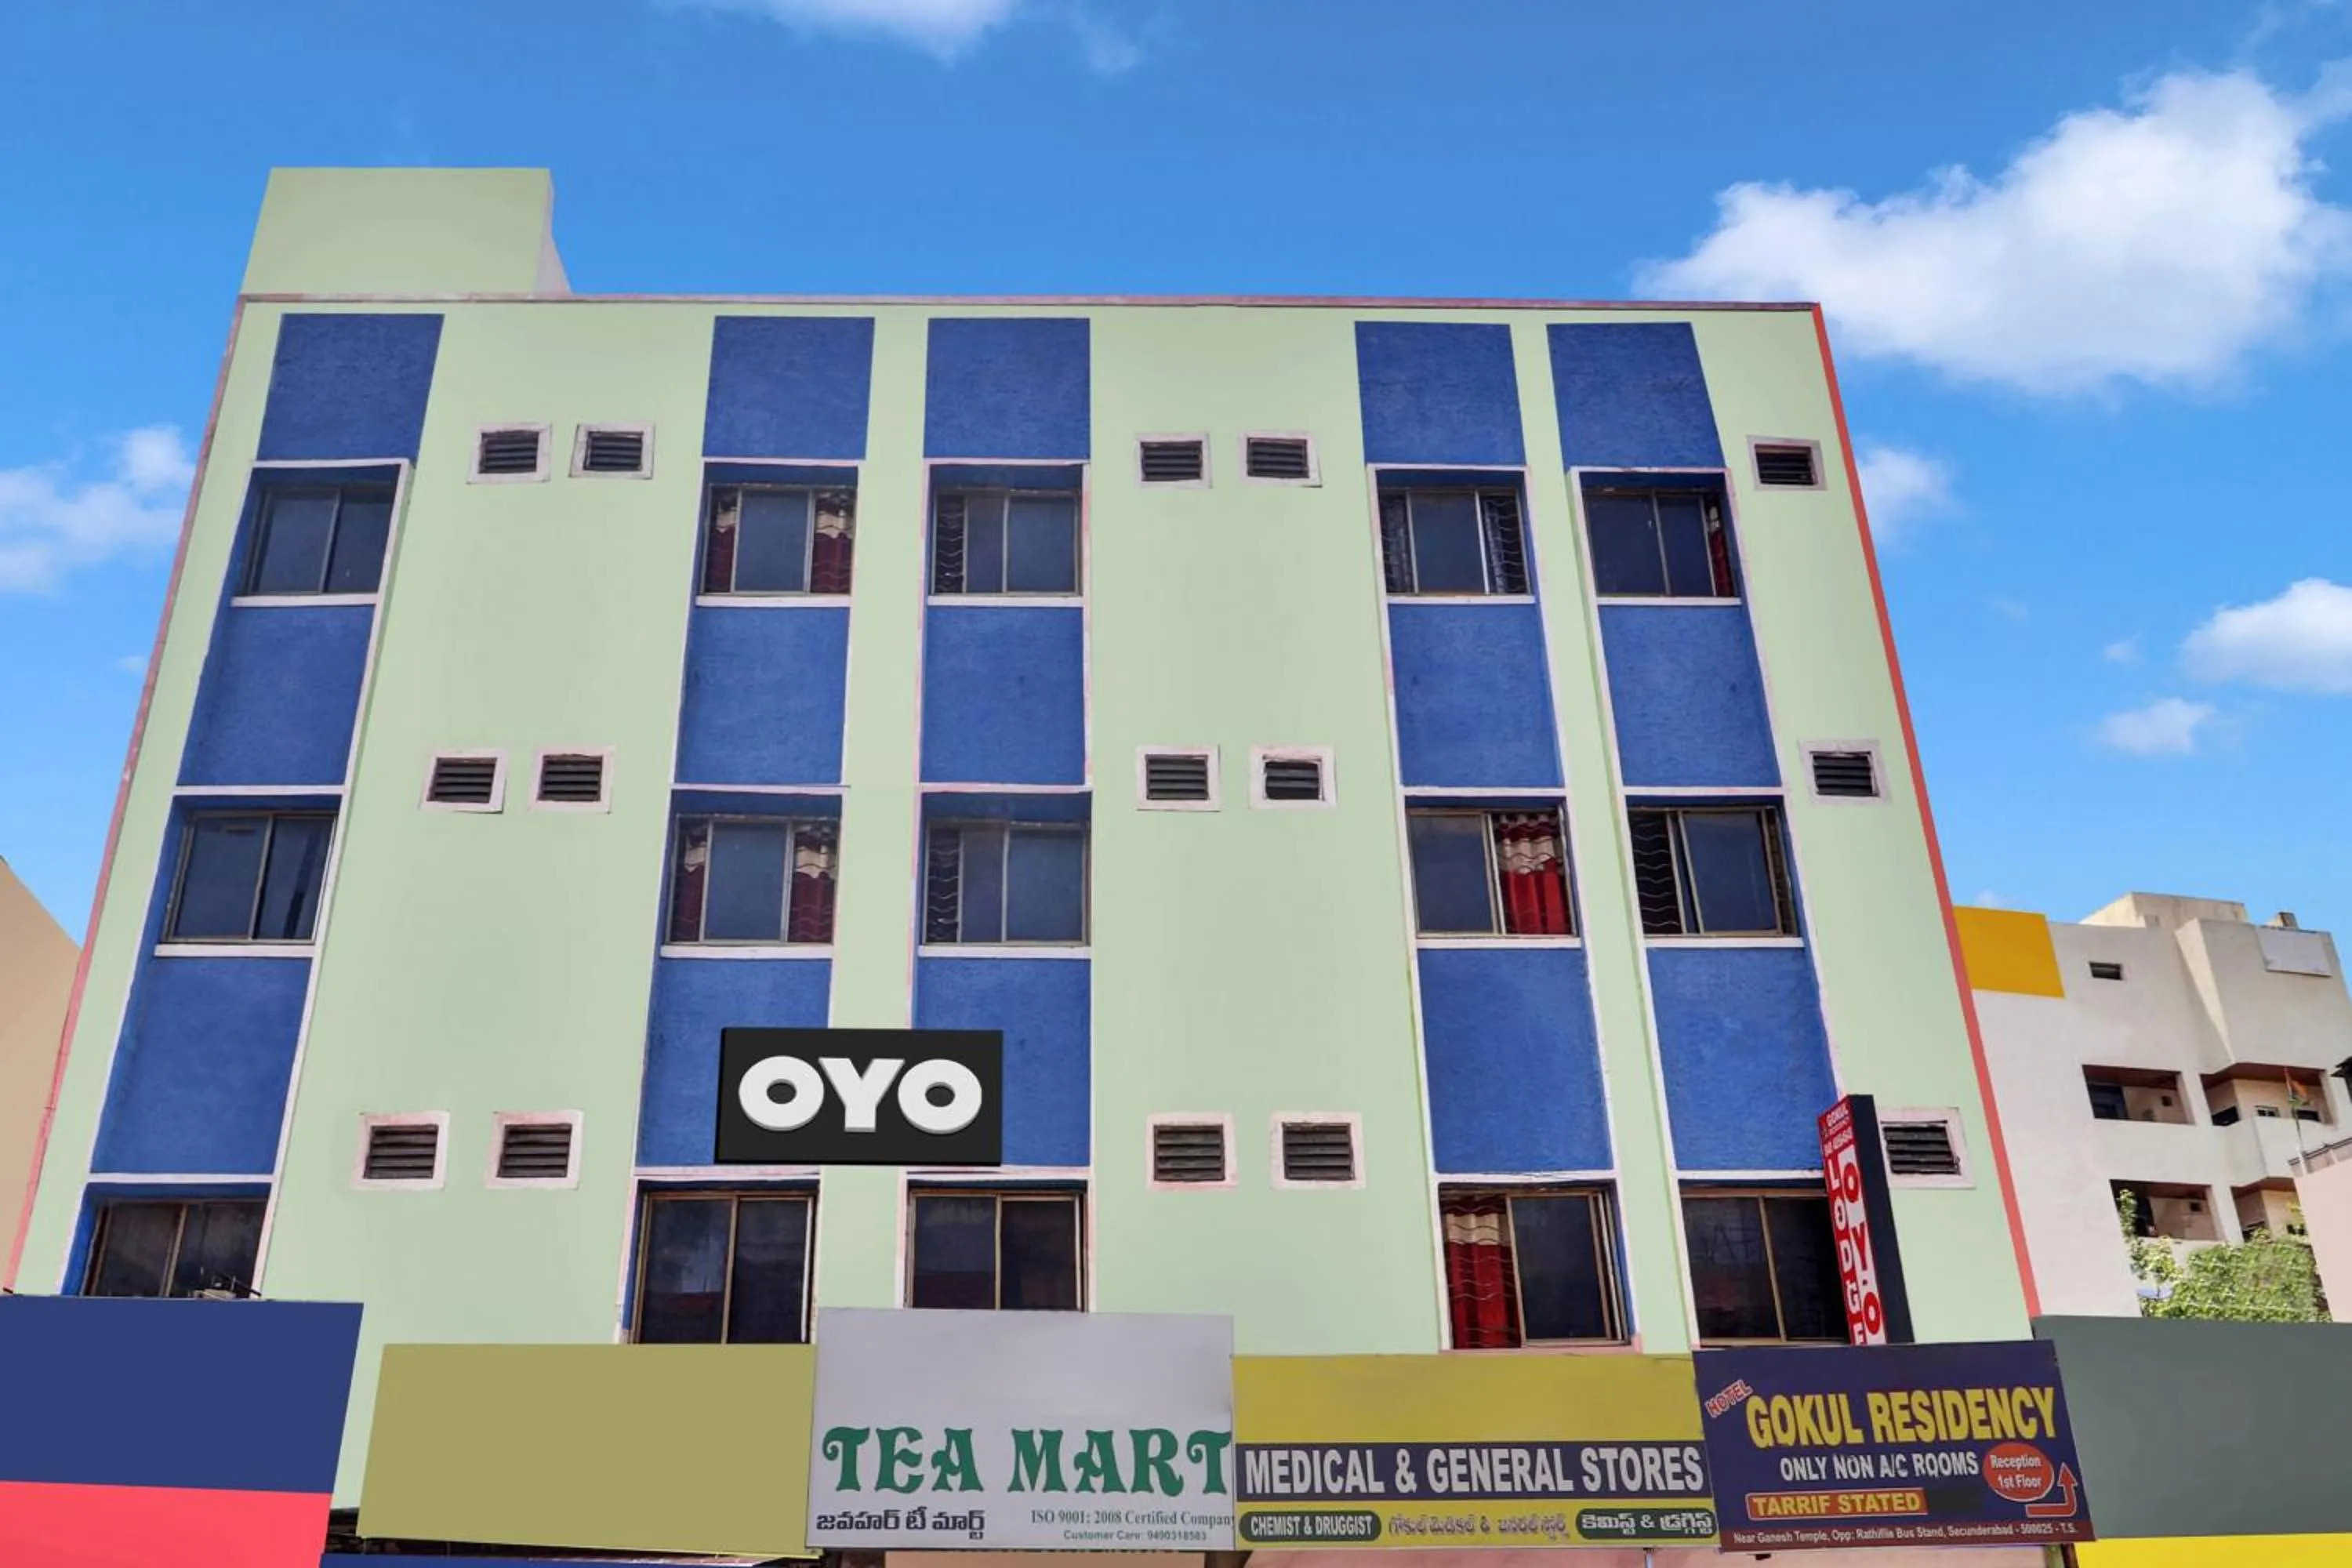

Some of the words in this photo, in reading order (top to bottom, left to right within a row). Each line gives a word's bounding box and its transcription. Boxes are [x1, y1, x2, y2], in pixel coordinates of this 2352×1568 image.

[739, 1055, 982, 1134] OYO
[1704, 1379, 1753, 1418] HOTEL
[1746, 1392, 1864, 1448] GOKUL
[1867, 1386, 2057, 1443] RESIDENCY
[822, 1426, 984, 1494] TEA
[1007, 1428, 1232, 1496] MART
[1245, 1449, 1385, 1494] MEDICAL
[1395, 1448, 1416, 1493] &
[1427, 1447, 1573, 1493] GENERAL
[1581, 1446, 1704, 1491] STORES
[1780, 1456, 1828, 1481] ONLY
[1832, 1454, 1875, 1479] NON
[1880, 1454, 1908, 1478] A/C
[1911, 1451, 1980, 1479] ROOMS
[1990, 1454, 2042, 1472] Reception
[1998, 1475, 2014, 1489] 1st
[2015, 1474, 2042, 1488] Floor
[1753, 1495, 1831, 1516] TARRIF
[1838, 1492, 1920, 1512] STATED
[1031, 1510, 1054, 1523] ISO
[1059, 1510, 1091, 1524] 9001:
[1094, 1511, 1122, 1525] 2008
[1125, 1510, 1177, 1525] Certified
[1250, 1516, 1301, 1536] CHEMIST
[1304, 1516, 1312, 1535] &
[1315, 1515, 1372, 1535] DRUGGIST
[1640, 1515, 1654, 1528] &
[1063, 1530, 1113, 1540] Customer
[1733, 1533, 1756, 1543] Near
[1758, 1532, 1793, 1543] Ganesh
[1896, 1527, 1915, 1538] Bus
[1948, 1524, 2014, 1537] Secunderabad
